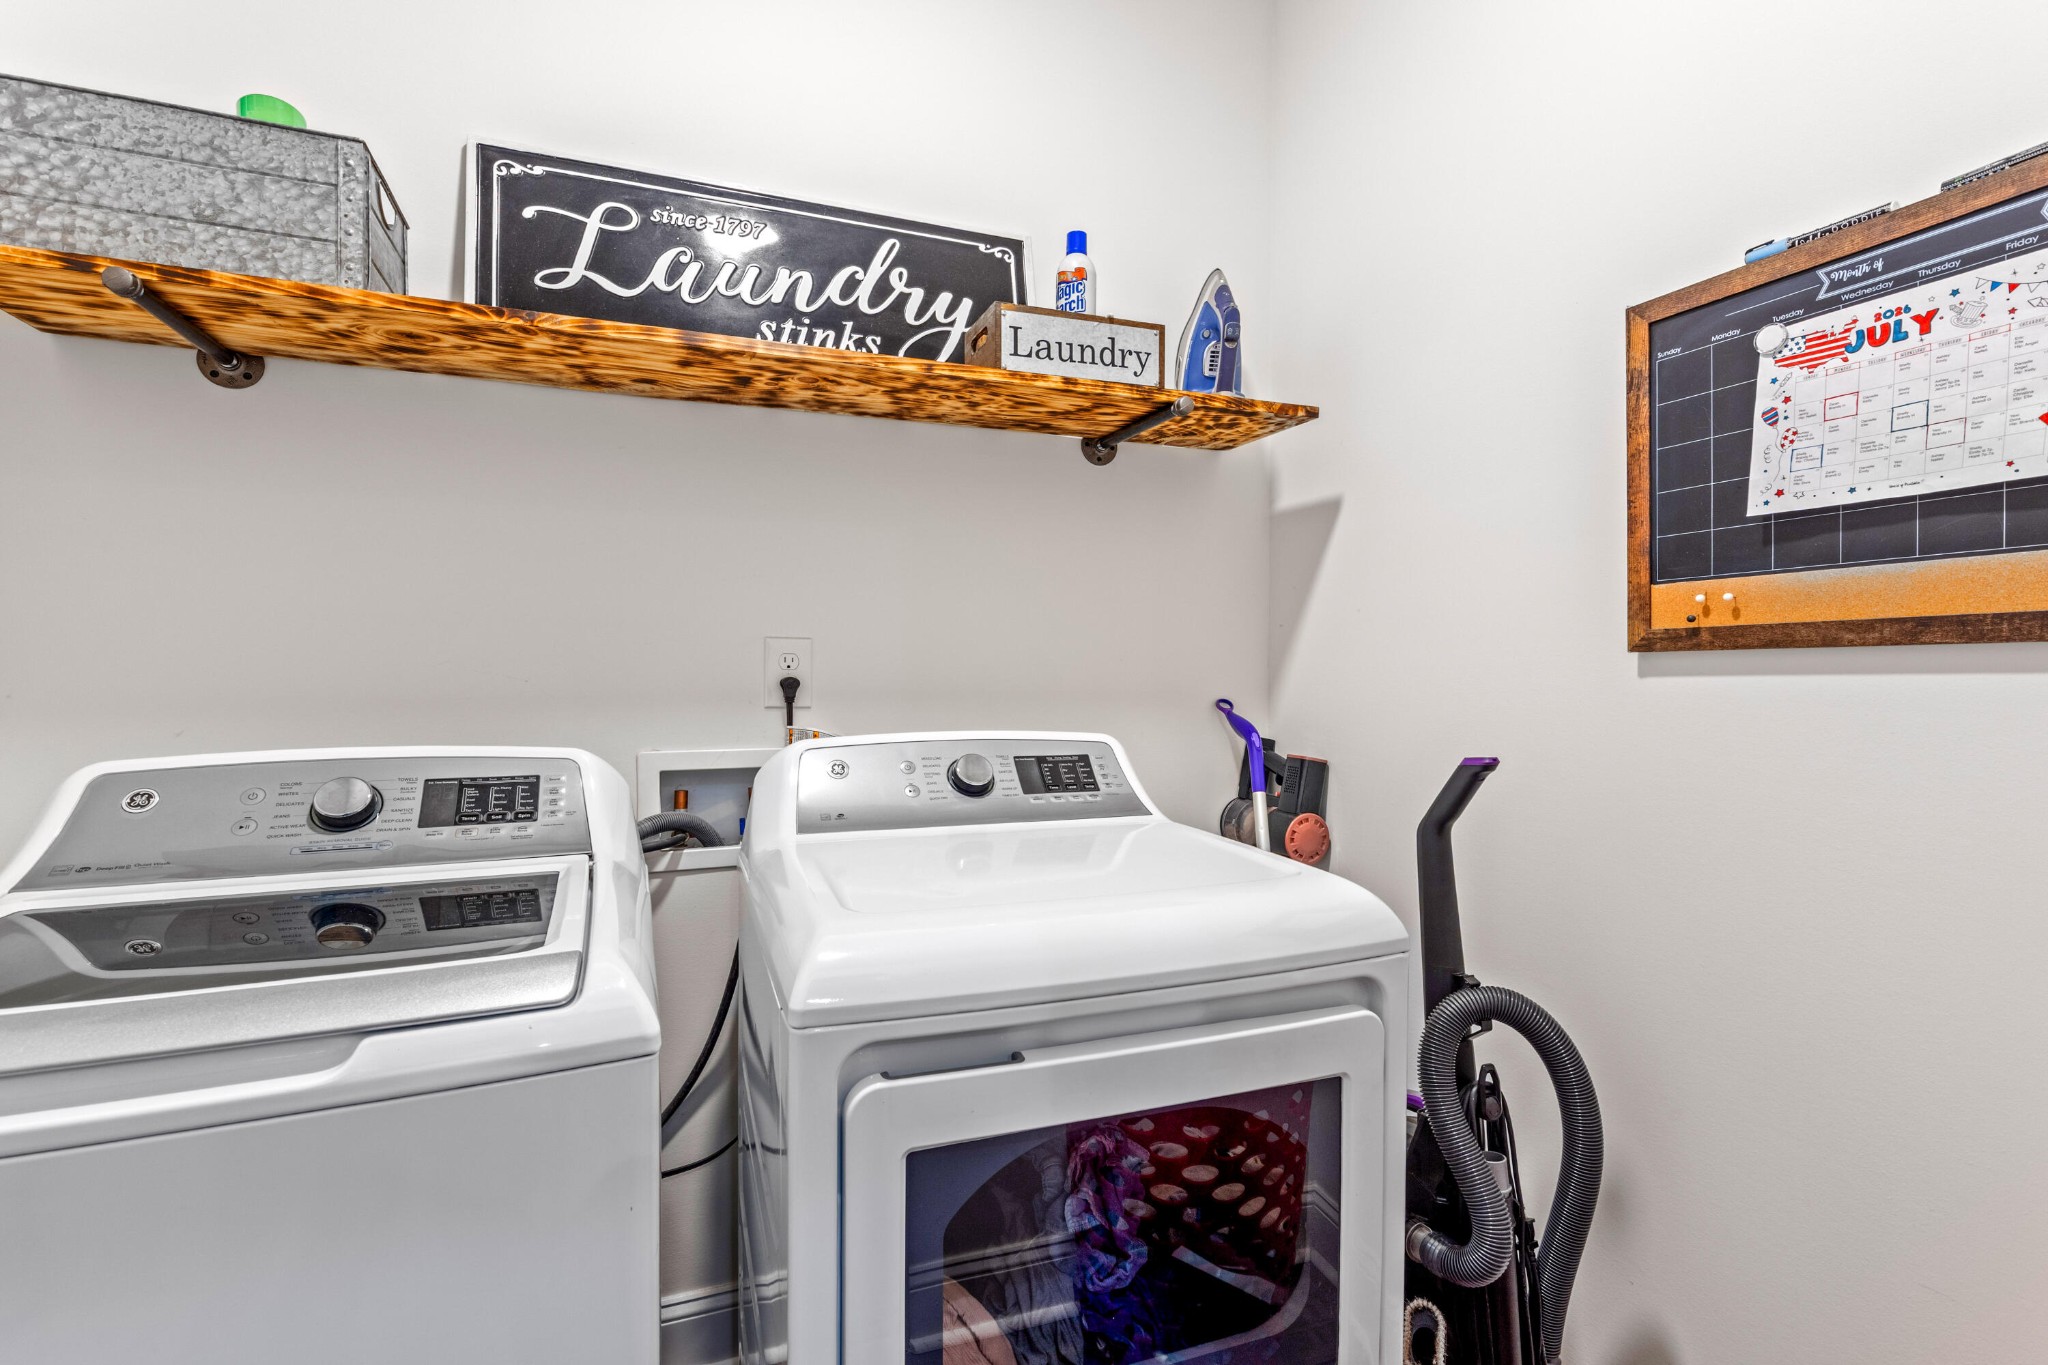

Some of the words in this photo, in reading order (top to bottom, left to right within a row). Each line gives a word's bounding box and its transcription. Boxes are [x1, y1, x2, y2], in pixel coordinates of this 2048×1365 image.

[2006, 235, 2040, 250] Friday
[1830, 260, 1871, 282] Month
[1873, 258, 1884, 272] of
[1918, 260, 1962, 278] Thursday
[521, 201, 974, 361] Laundry
[1841, 280, 1894, 301] Wednesday
[1772, 308, 1805, 322] Tuesday
[1874, 304, 1912, 323] 2026
[756, 317, 881, 354] stinks
[1711, 328, 1741, 342] Monday
[1845, 308, 1939, 354] JULY
[1009, 325, 1152, 377] Laundry
[1657, 346, 1682, 358] Sunday
